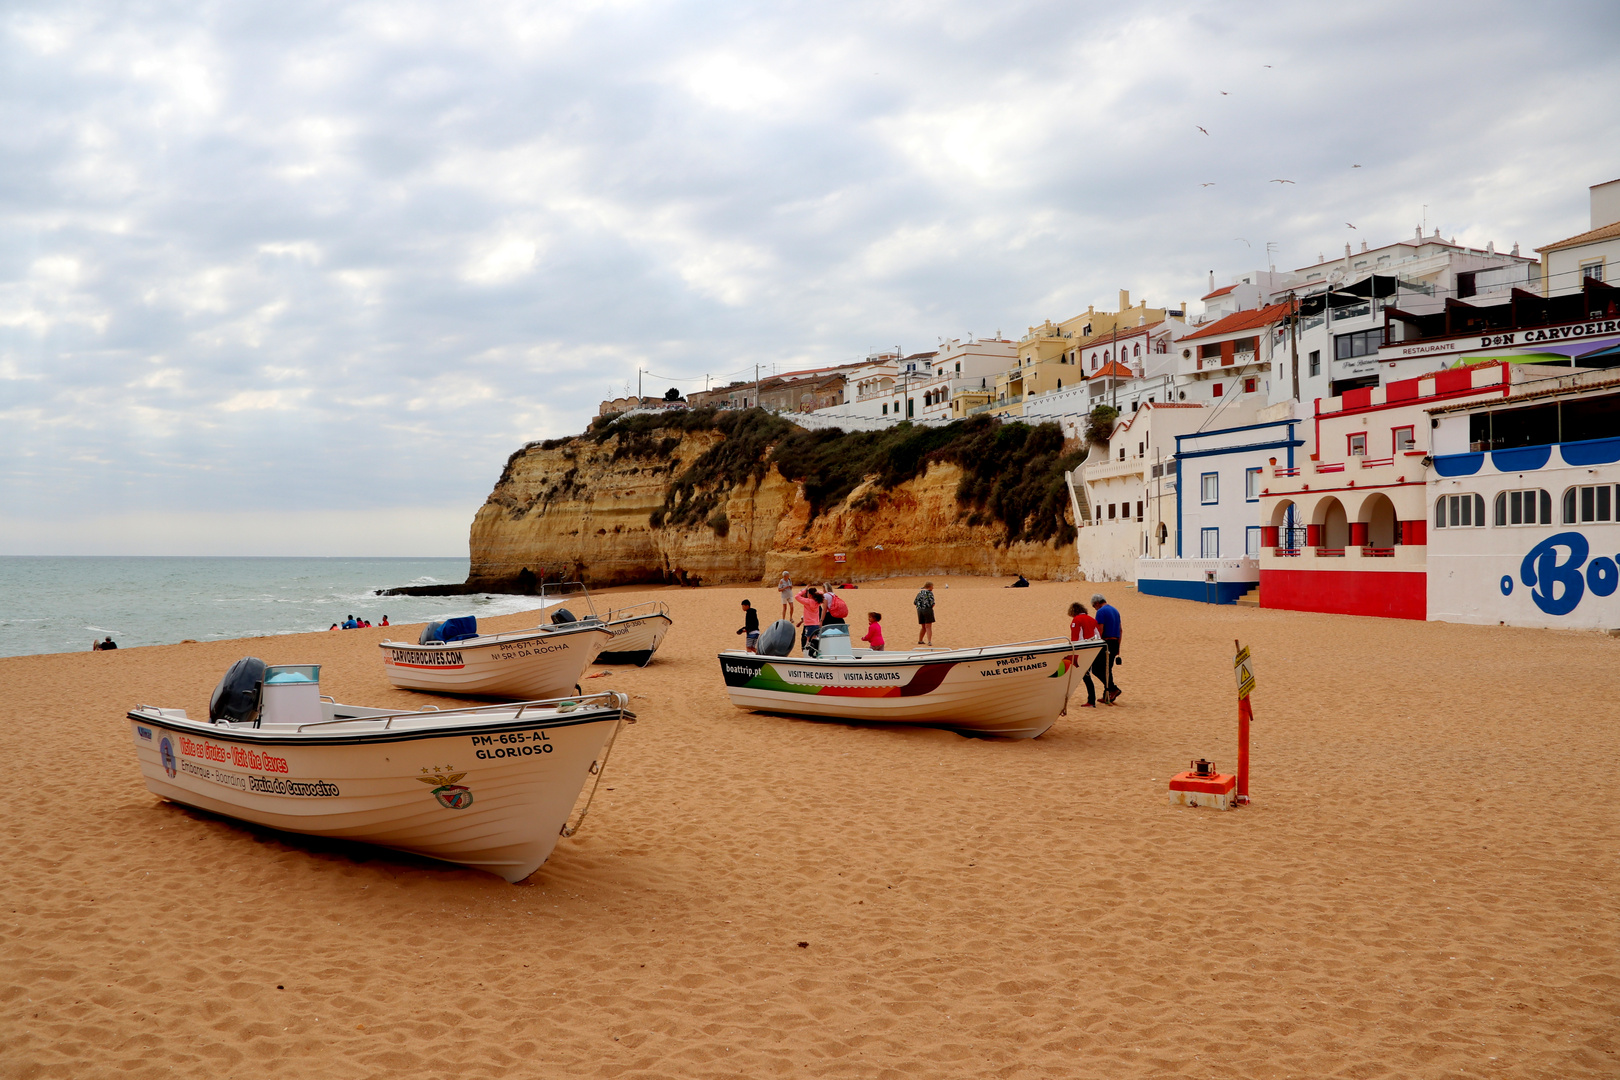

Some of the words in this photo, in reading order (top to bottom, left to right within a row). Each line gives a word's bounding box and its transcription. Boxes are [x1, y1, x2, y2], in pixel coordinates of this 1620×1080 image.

[1524, 320, 1620, 341] CARVOEIR
[1402, 343, 1456, 355] RESTAURANTE
[1520, 531, 1620, 616] Bo
[499, 638, 549, 651] PM-671-AL
[518, 649, 532, 658] DA
[534, 643, 570, 655] ROCHA
[391, 649, 464, 665] CARVOEIROCAVES.COM
[996, 654, 1037, 667] PM-657-AL
[725, 662, 762, 677] boattrip.pt
[787, 670, 802, 678] VISIT
[802, 671, 814, 679] THE
[814, 672, 834, 680] CAVES
[843, 672, 863, 681] VISITA
[864, 671, 873, 681] ÀS
[874, 672, 901, 681] GRUTAS
[980, 668, 1001, 677] VALE
[1002, 661, 1048, 675] CENTIANES
[471, 731, 550, 746] PM-665-AL
[204, 741, 226, 763] Grutas
[231, 746, 248, 767] Visit
[248, 750, 262, 770] the
[262, 751, 289, 774] Caves
[476, 743, 554, 760] GLORIOSO
[181, 759, 210, 779] Embarque
[215, 769, 246, 791] Boarding
[249, 775, 274, 793] Praia
[274, 778, 286, 794] do
